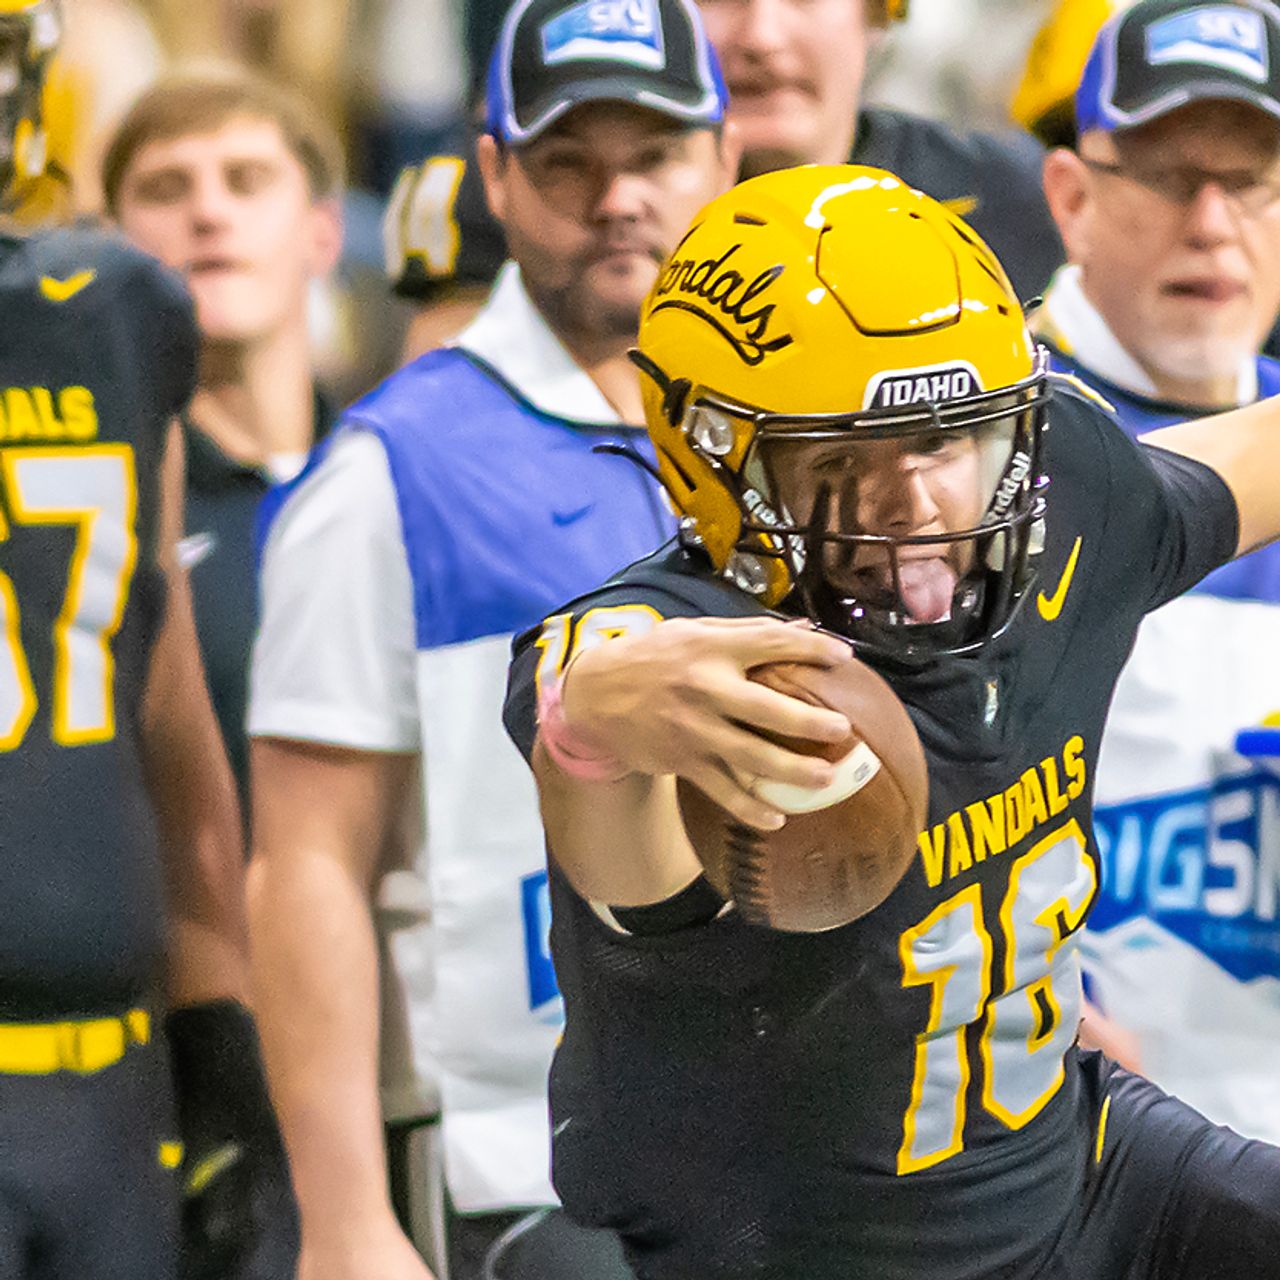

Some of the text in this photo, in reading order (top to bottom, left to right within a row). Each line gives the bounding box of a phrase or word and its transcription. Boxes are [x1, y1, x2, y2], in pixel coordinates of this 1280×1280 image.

[0, 386, 97, 441] ALS
[881, 370, 972, 407] IDAHO
[918, 735, 1087, 888] VANDALS
[897, 817, 1098, 1176] 16
